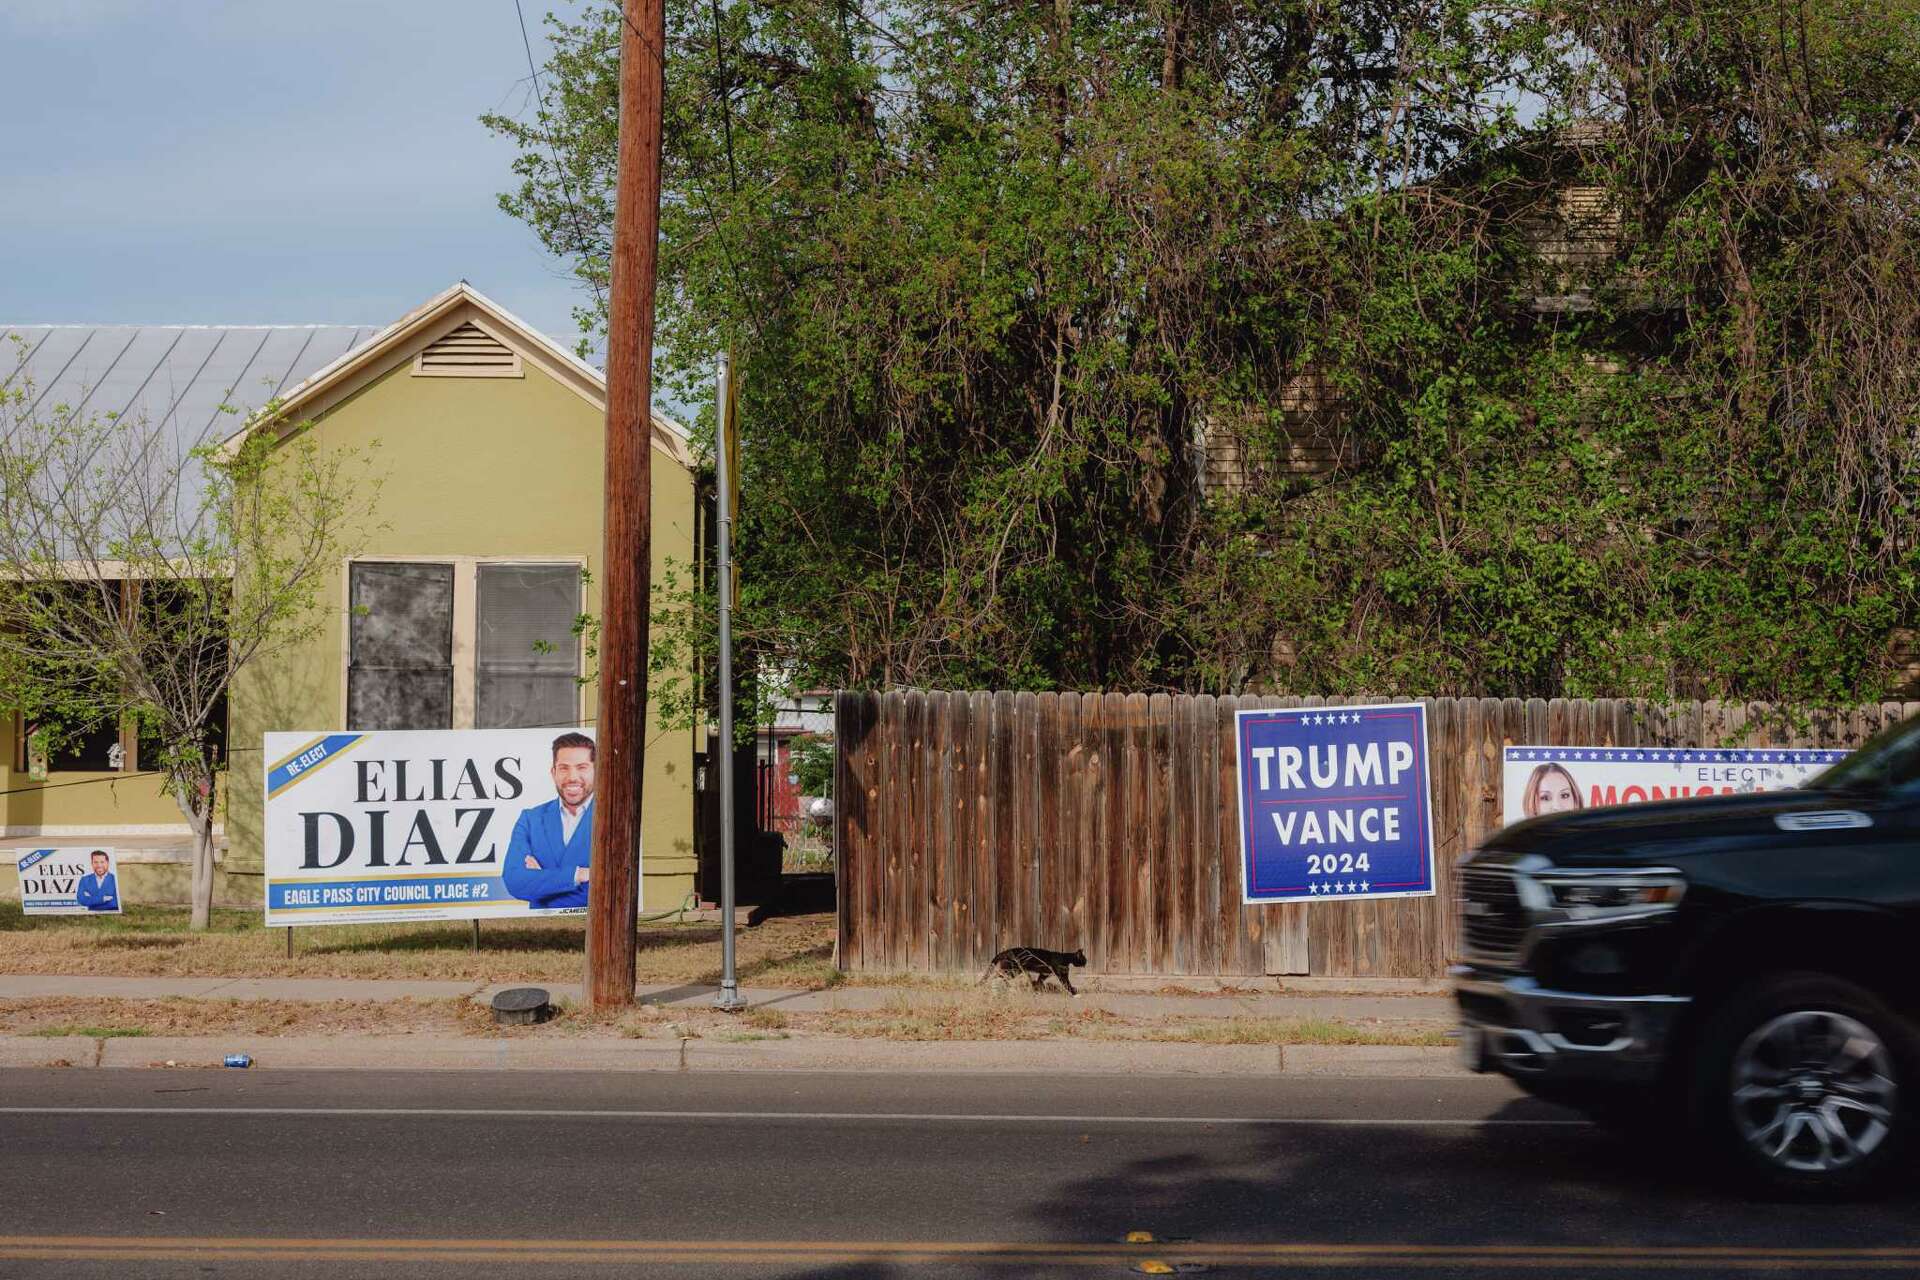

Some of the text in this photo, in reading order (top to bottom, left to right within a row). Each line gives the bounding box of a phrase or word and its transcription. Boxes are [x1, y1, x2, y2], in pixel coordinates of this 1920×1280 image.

[286, 744, 328, 777] RE-ELECT
[1252, 741, 1414, 791] TRUMP
[1698, 767, 1767, 781] ELECT
[352, 757, 524, 803] ELIAS
[298, 807, 496, 870] DIAZ
[1271, 807, 1401, 846] VANCE
[39, 864, 85, 876] ELIAS
[1306, 852, 1371, 875] 2024
[23, 879, 76, 894] DIAZ
[284, 883, 489, 905] EAGLE PASS CITY COUNCIL PLACE #2
